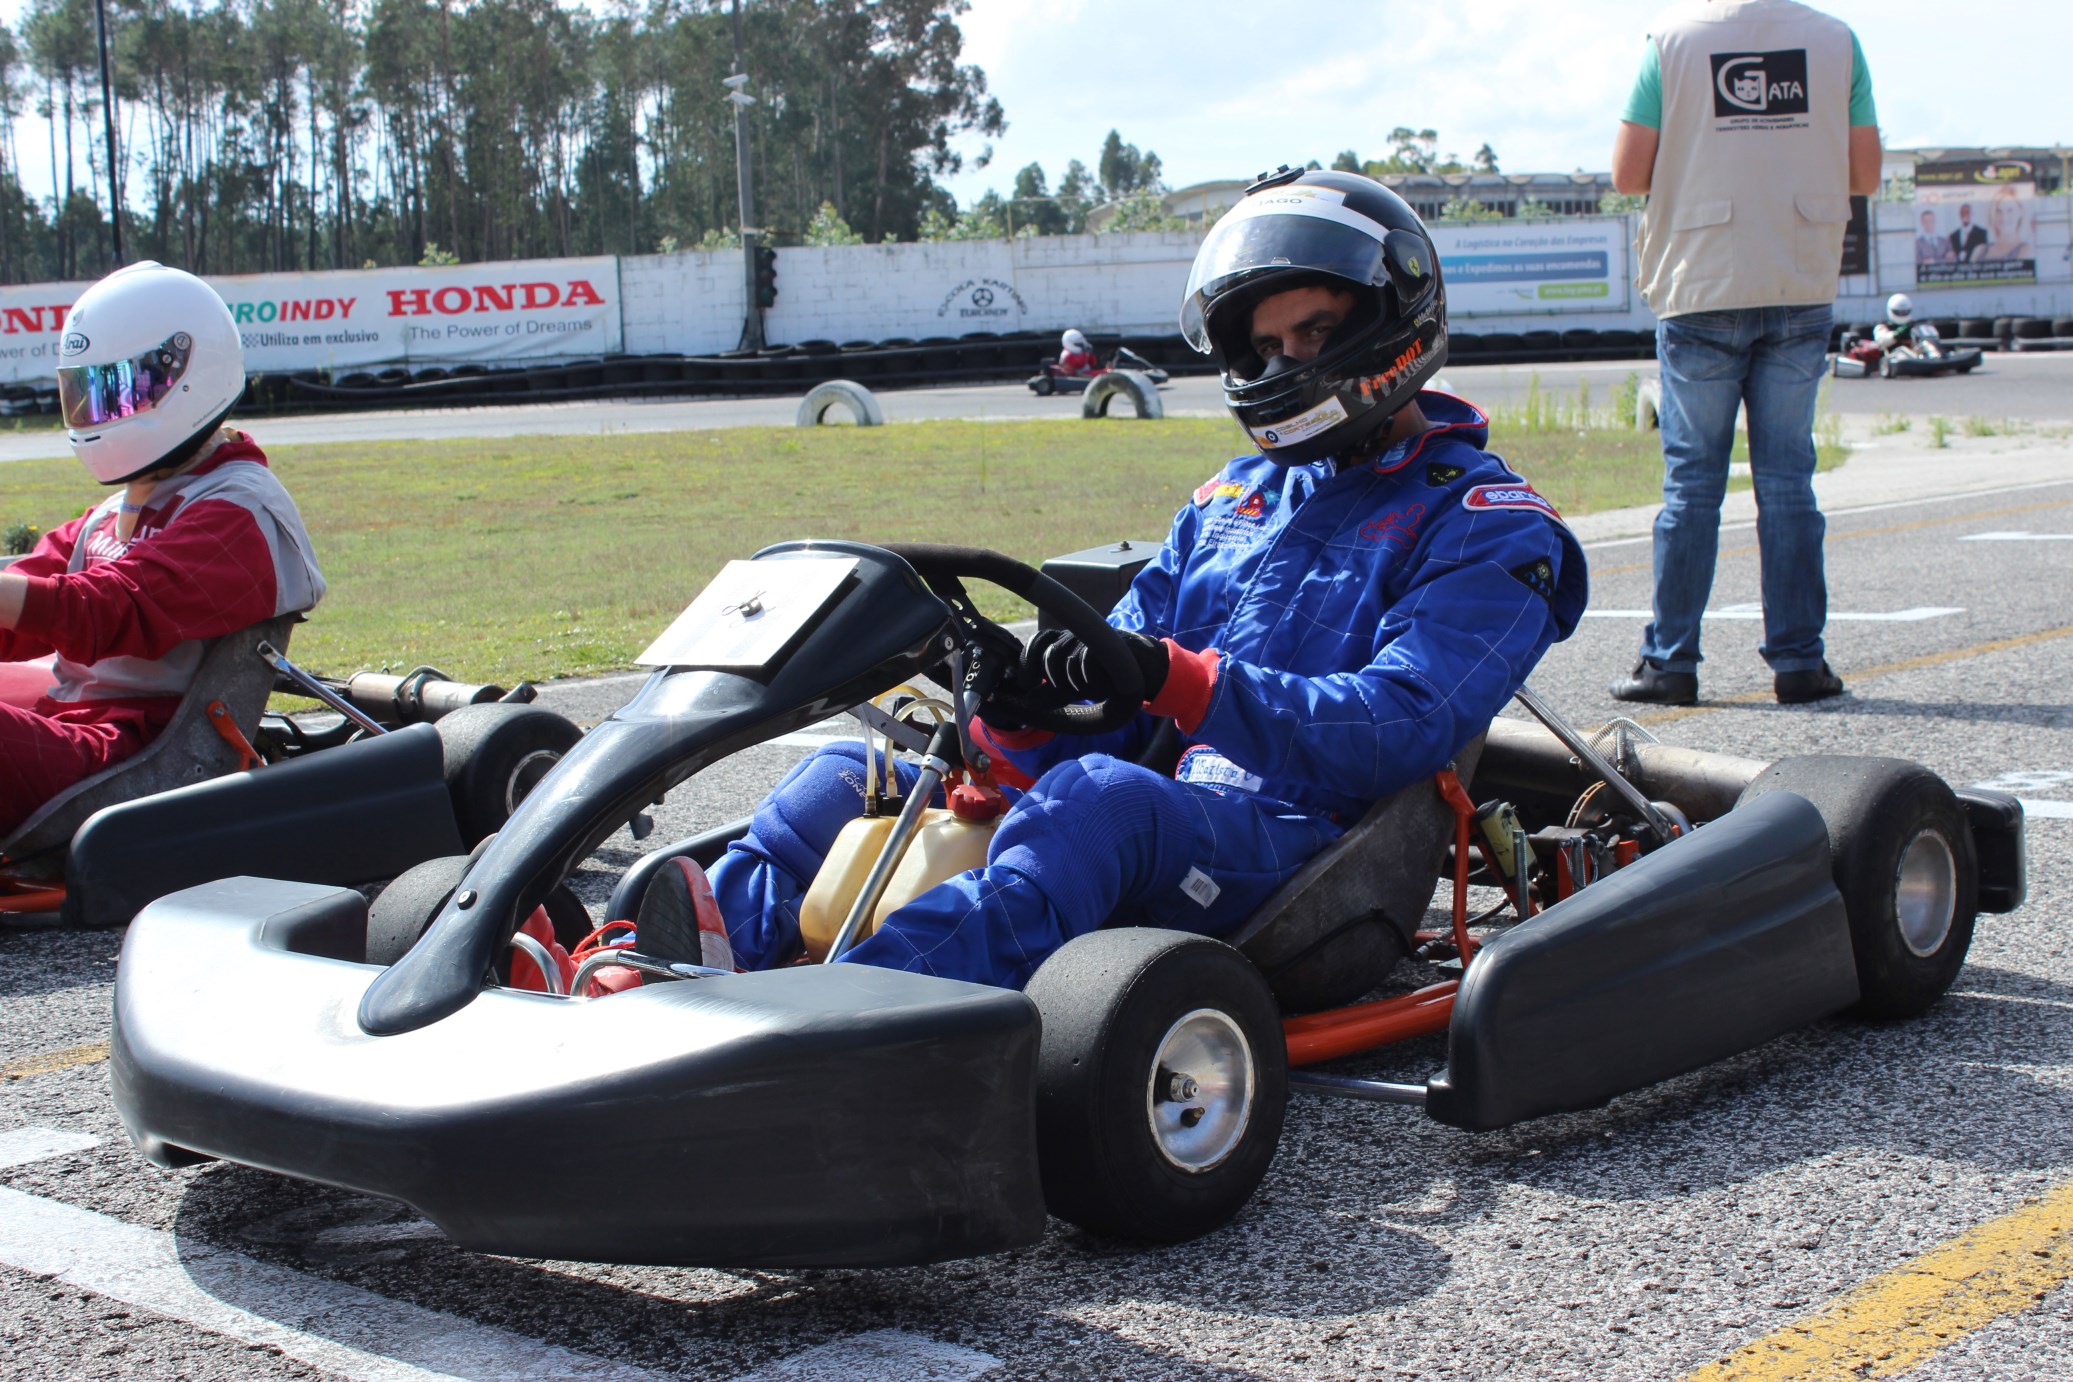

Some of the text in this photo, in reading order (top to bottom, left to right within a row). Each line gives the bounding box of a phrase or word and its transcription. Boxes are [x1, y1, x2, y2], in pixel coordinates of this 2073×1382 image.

[1717, 56, 1804, 110] GATA
[386, 280, 606, 317] HONDA
[260, 329, 379, 347] Utiliza em exclusivo
[409, 318, 593, 340] The Power of Dreams
[31, 342, 47, 358] of
[64, 335, 85, 350] Arai
